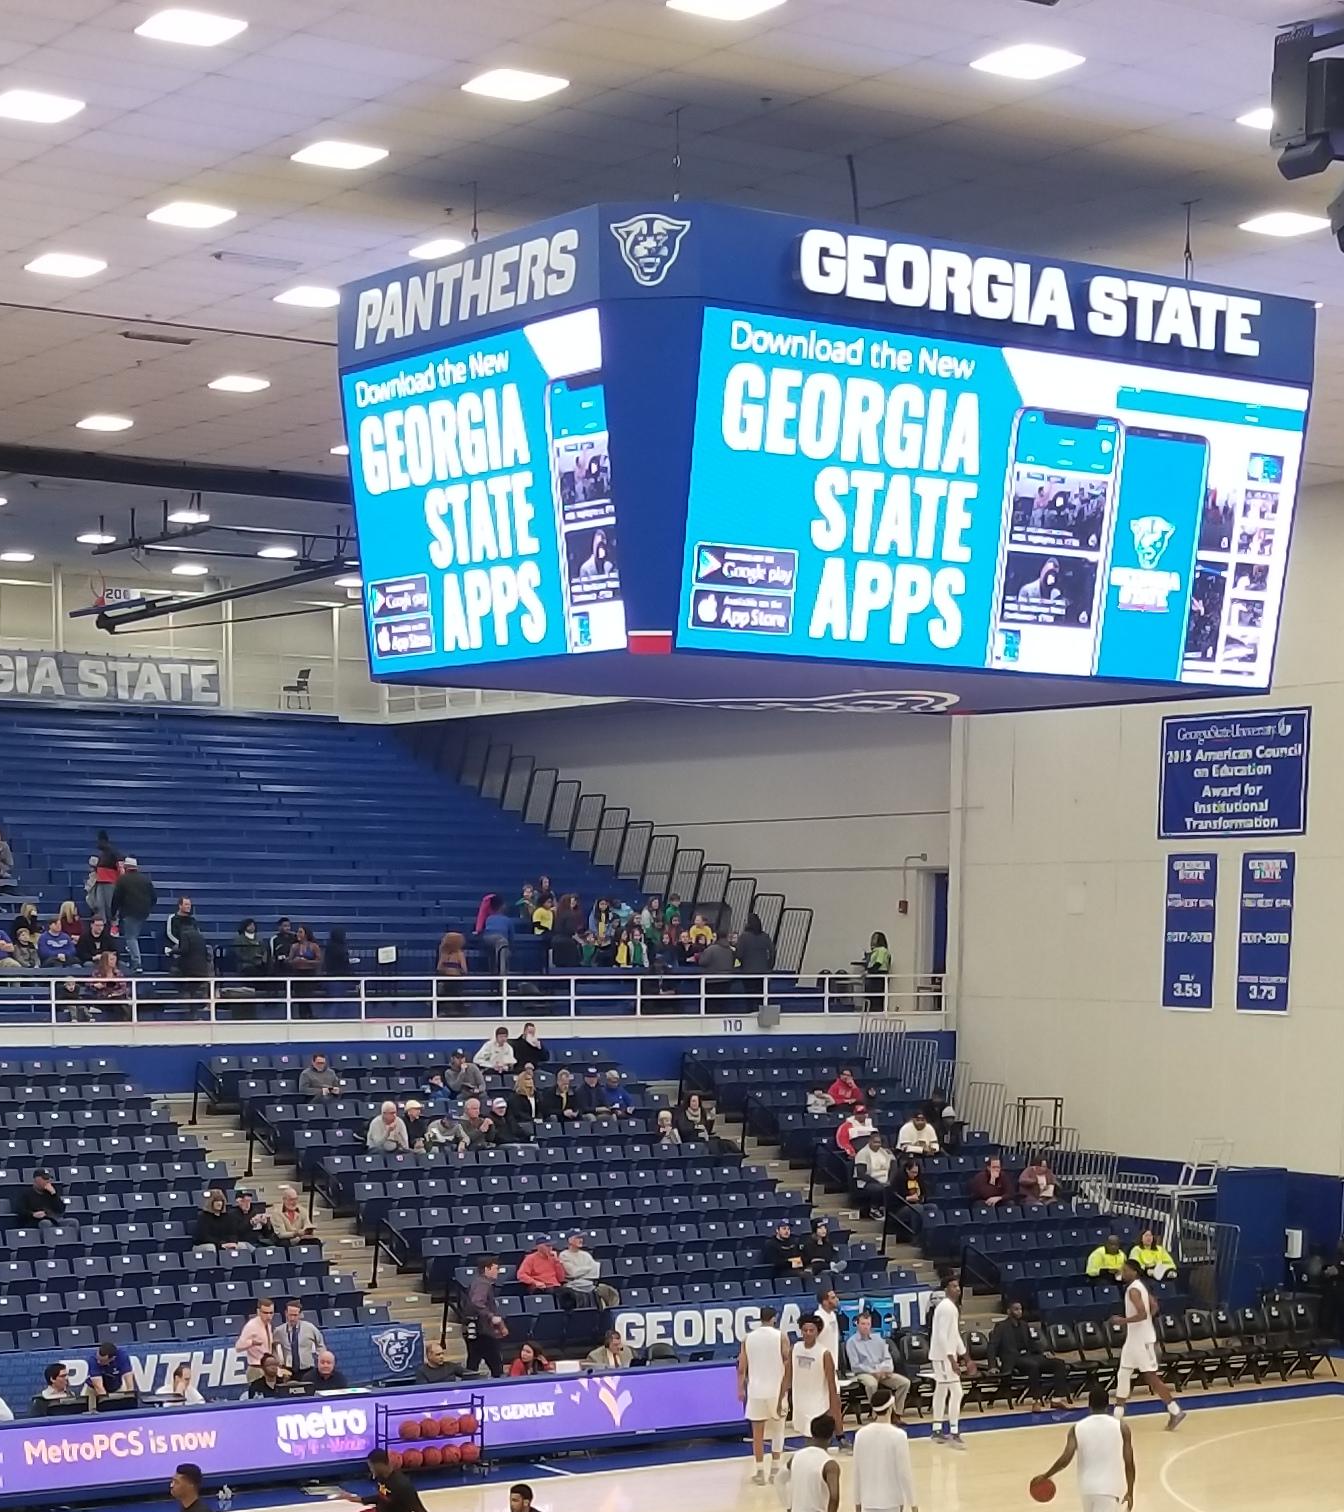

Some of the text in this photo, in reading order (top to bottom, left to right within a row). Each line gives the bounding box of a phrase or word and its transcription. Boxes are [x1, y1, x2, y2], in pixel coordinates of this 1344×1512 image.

[354, 228, 579, 350] PANTHERS
[799, 228, 1262, 357] GEORGIA STATE
[730, 319, 976, 380] Download the New
[355, 350, 510, 409] Download the New
[721, 362, 980, 476] GEORGIA
[359, 383, 531, 496] GEORGIA
[424, 470, 541, 569] STATE
[810, 466, 979, 563] STATE
[722, 562, 793, 586] Google play
[442, 560, 547, 652] APPS
[721, 607, 787, 628] App Store
[808, 556, 966, 649] APPS
[77, 658, 220, 704] STATE
[1167, 743, 1302, 763] 2015 American Council
[1194, 763, 1272, 778] on Education
[1194, 799, 1269, 814] Institutional
[1202, 783, 1263, 798] Award for
[1185, 815, 1279, 830] Transformation
[1173, 983, 1201, 997] 3.53
[1248, 985, 1277, 1000] 3.73
[385, 1025, 414, 1039] 108
[723, 1019, 743, 1032] 110
[275, 1404, 368, 1441] metro
[23, 1427, 218, 1465] MetroPCS is now
